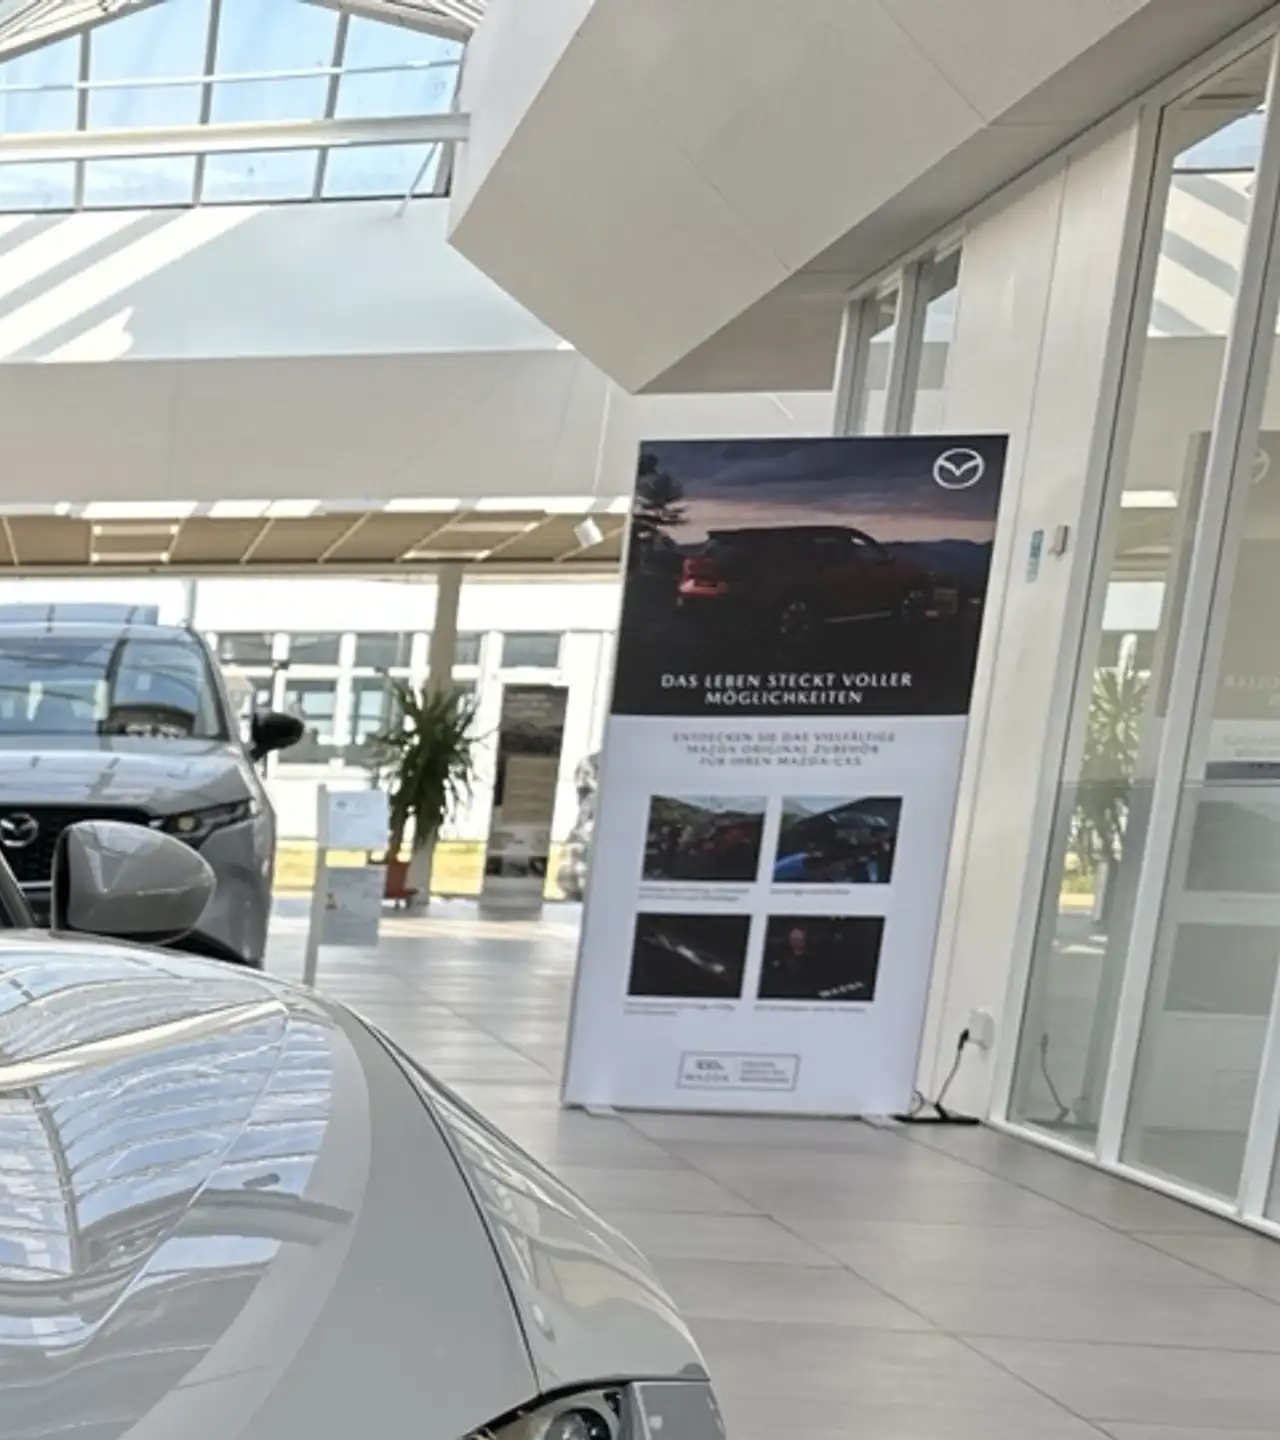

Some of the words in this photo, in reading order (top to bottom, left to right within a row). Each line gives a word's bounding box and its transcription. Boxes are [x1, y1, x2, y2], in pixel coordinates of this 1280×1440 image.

[661, 673, 698, 689] DAS
[704, 673, 761, 689] LEBEN
[766, 673, 836, 688] STECKT
[842, 672, 912, 687] VOLLER
[704, 689, 864, 705] MÖGLICHKEITEN
